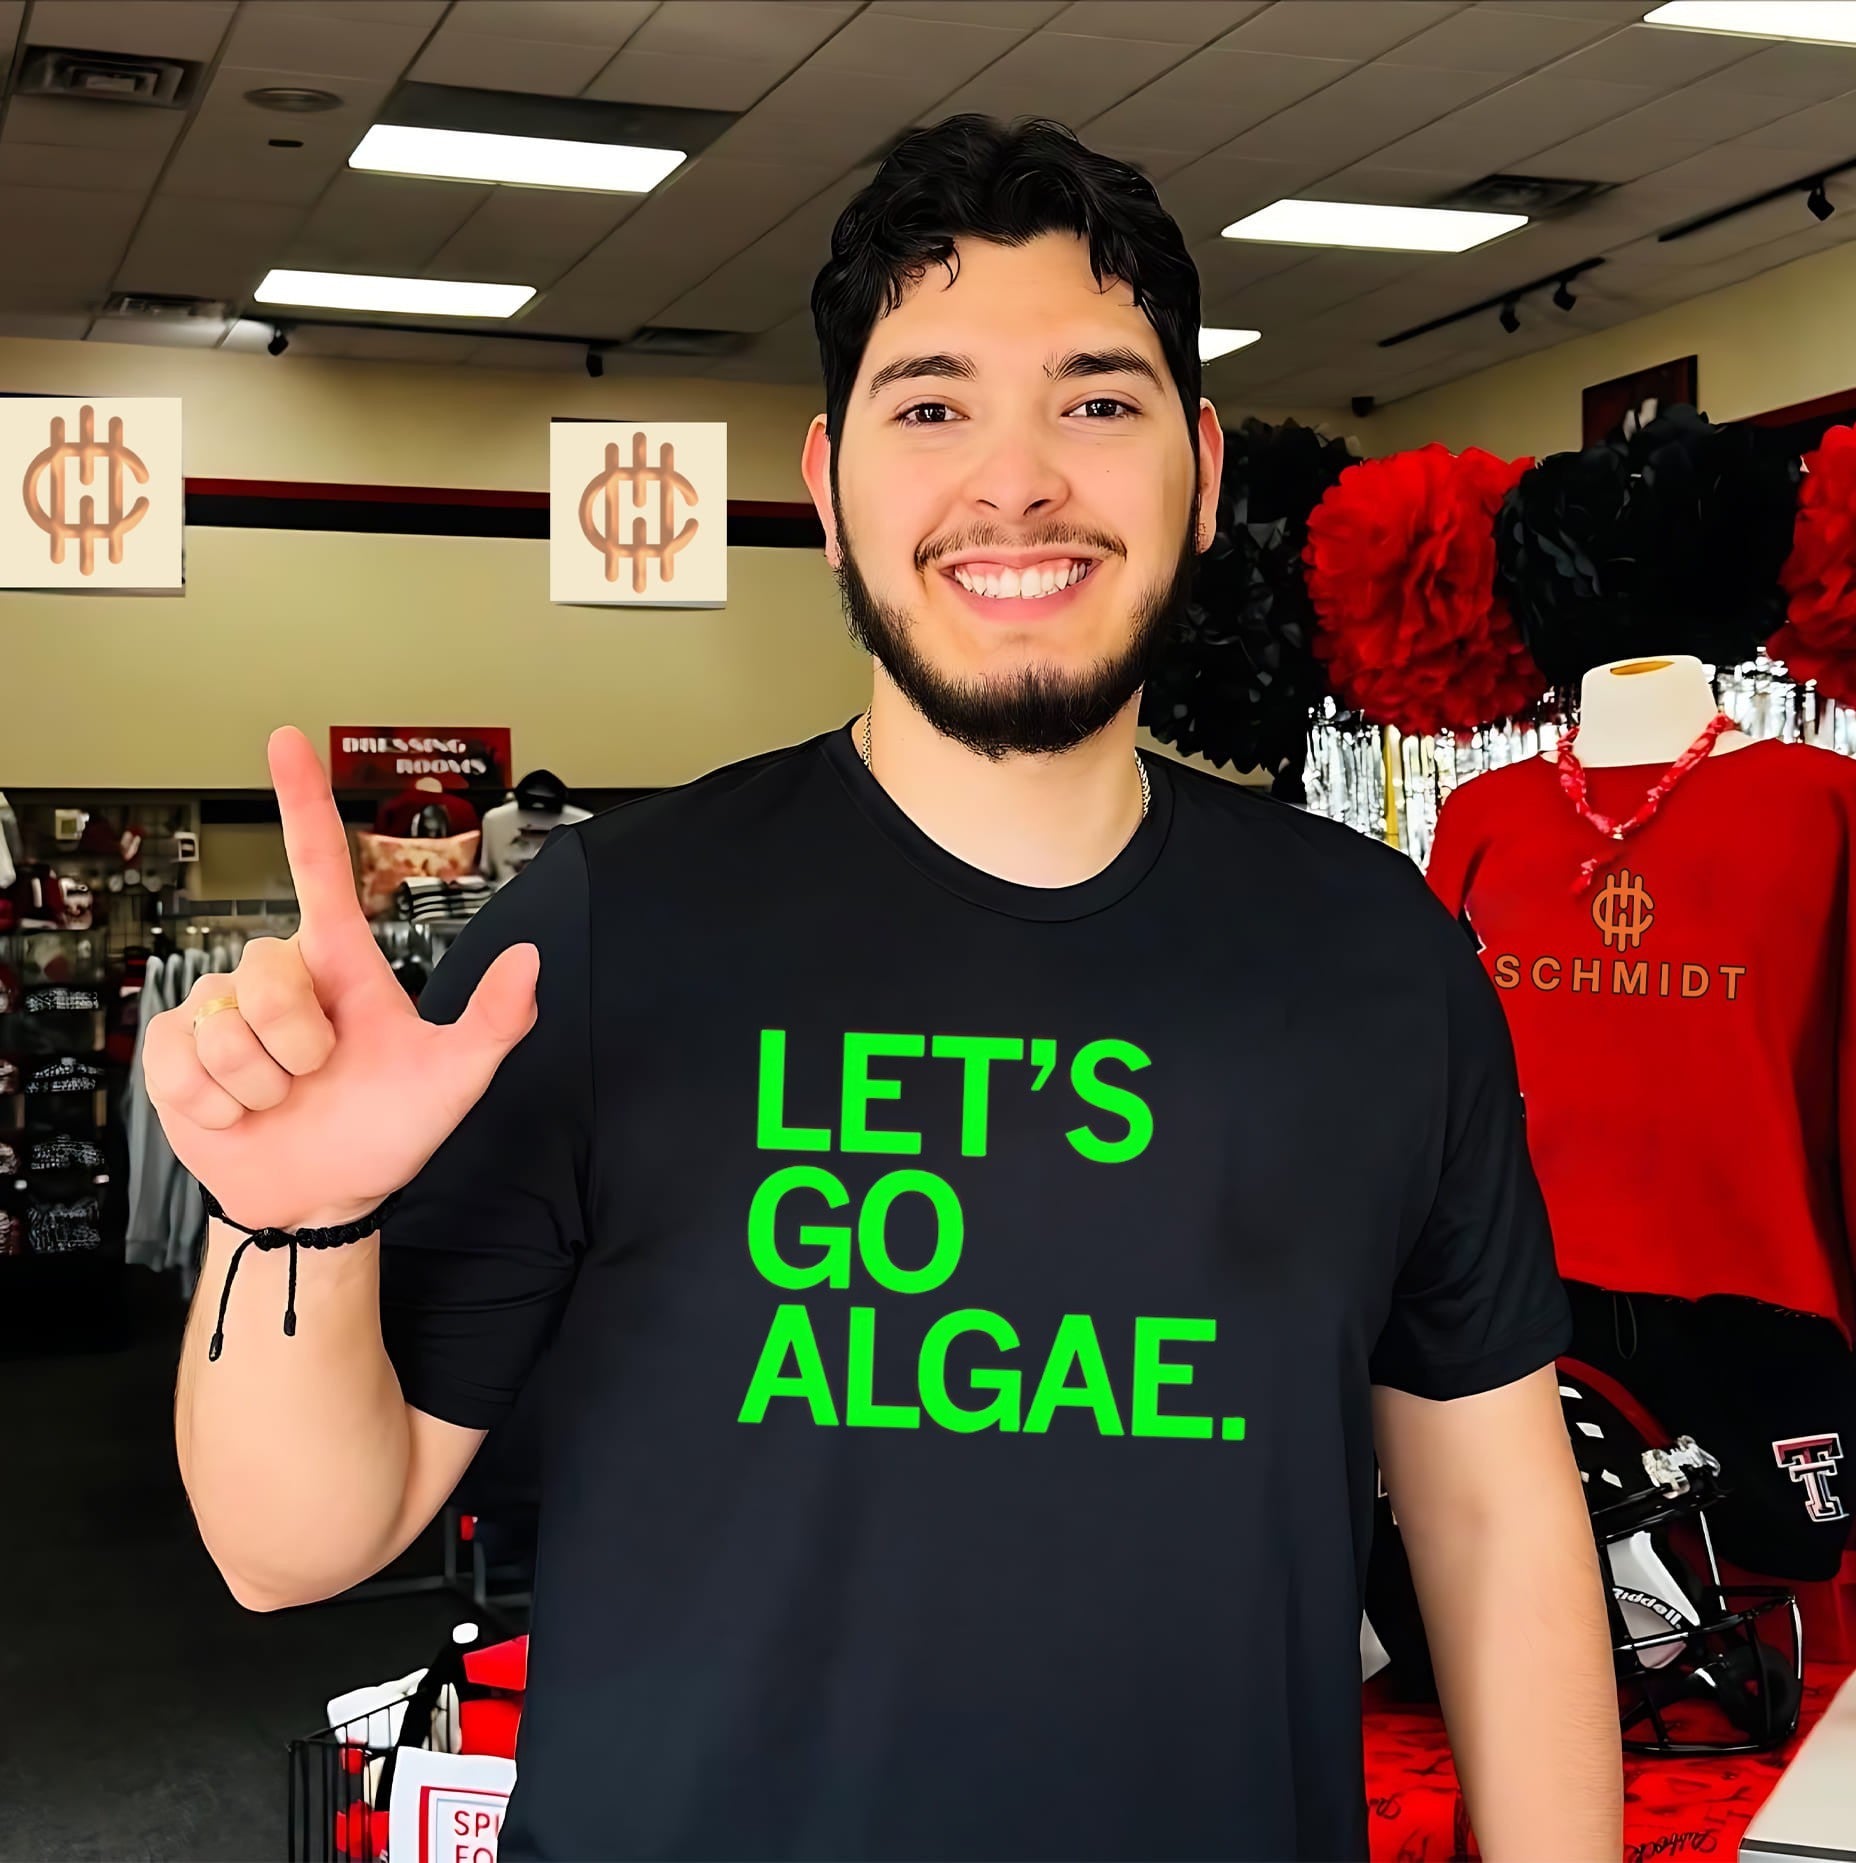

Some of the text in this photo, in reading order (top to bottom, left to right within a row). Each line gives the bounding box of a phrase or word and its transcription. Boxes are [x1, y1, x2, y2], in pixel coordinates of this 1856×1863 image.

[342, 737, 466, 753] DRESSING
[396, 758, 487, 775] ROOMS
[1494, 954, 1746, 1000] SCHMIDT
[757, 1029, 1154, 1163] LET’S
[748, 1165, 964, 1293] GO
[737, 1304, 1245, 1441] ALGAE.
